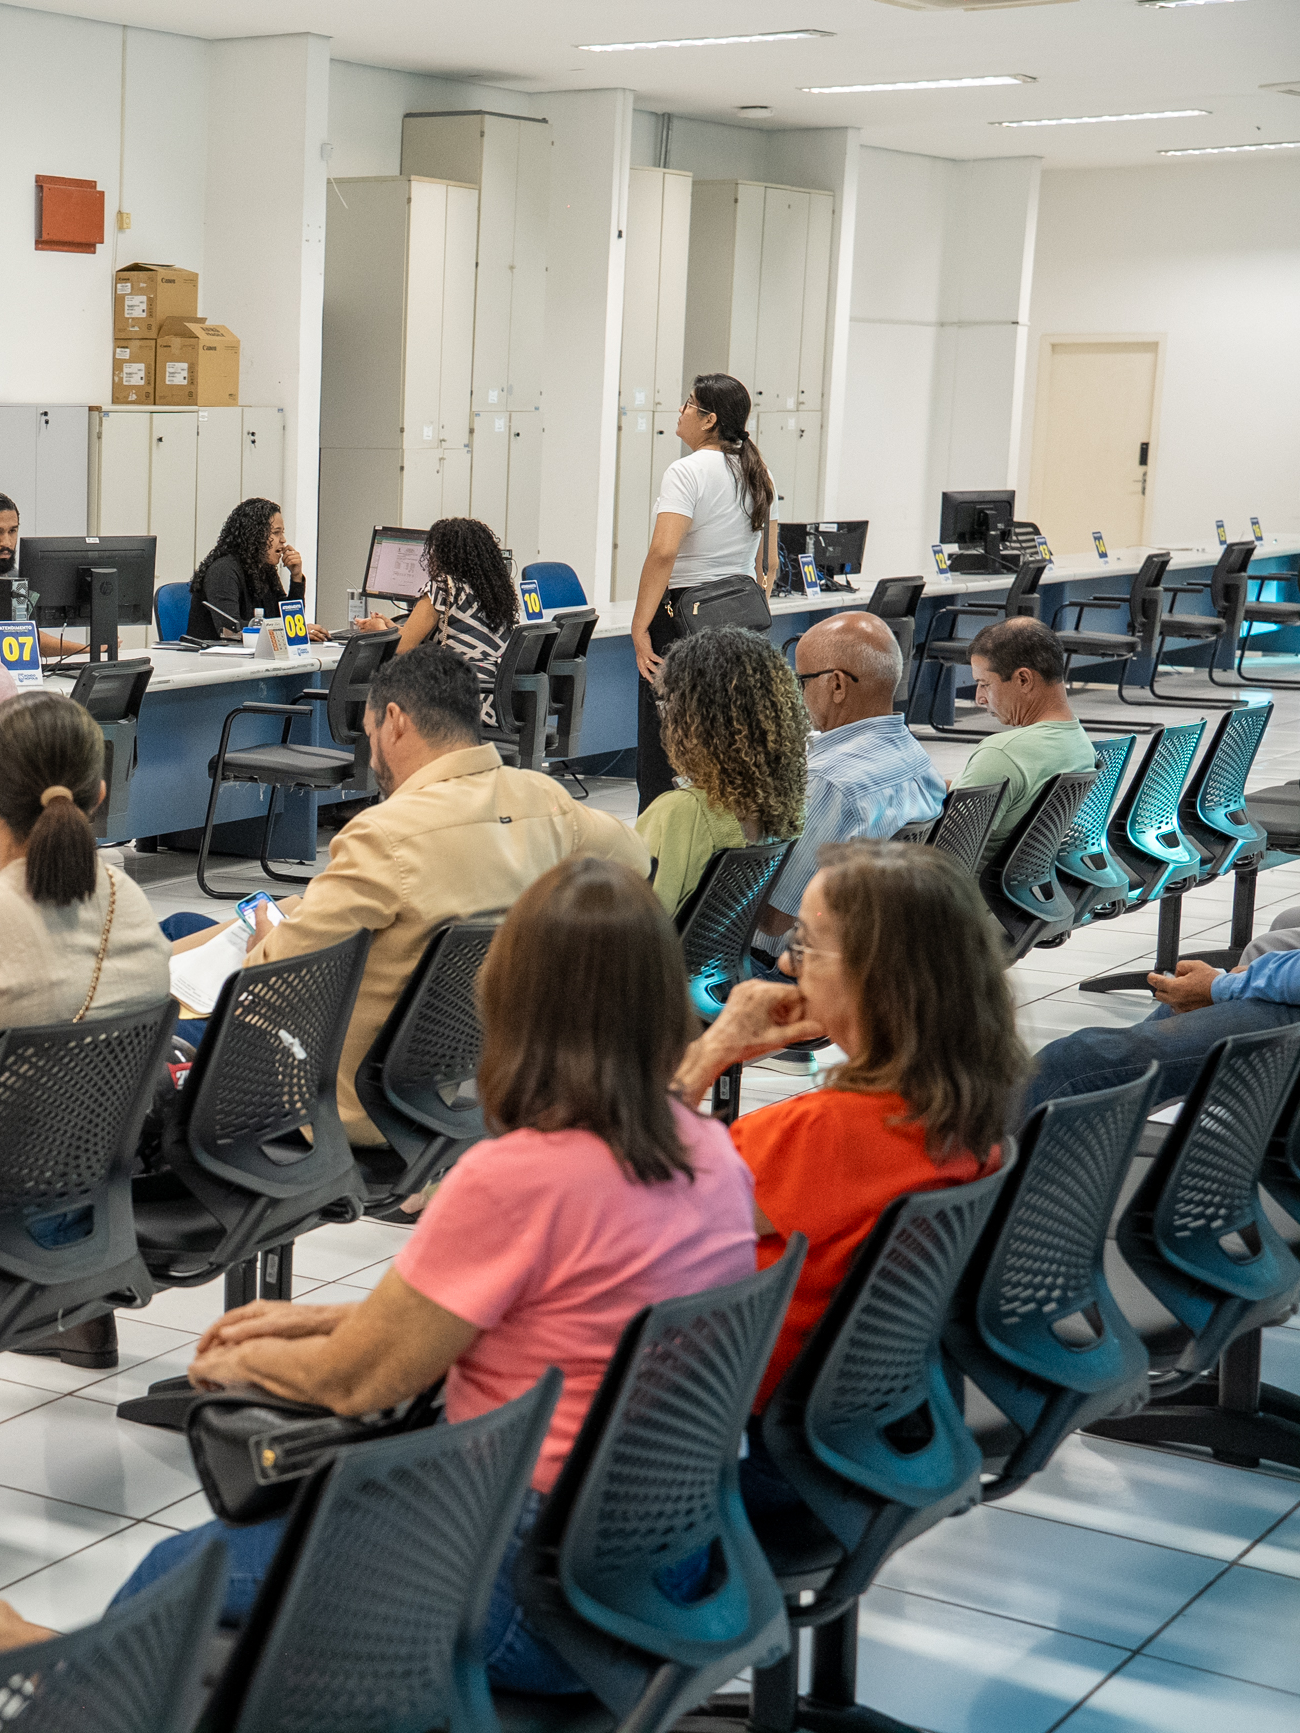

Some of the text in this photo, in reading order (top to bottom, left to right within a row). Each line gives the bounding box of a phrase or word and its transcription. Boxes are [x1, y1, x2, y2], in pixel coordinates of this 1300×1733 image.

[1039, 546, 1050, 559] 13
[1096, 538, 1106, 554] 14
[935, 554, 947, 569] 12
[804, 565, 816, 582] 11
[524, 592, 540, 613] 10
[285, 614, 306, 638] 08
[2, 636, 34, 662] 07
